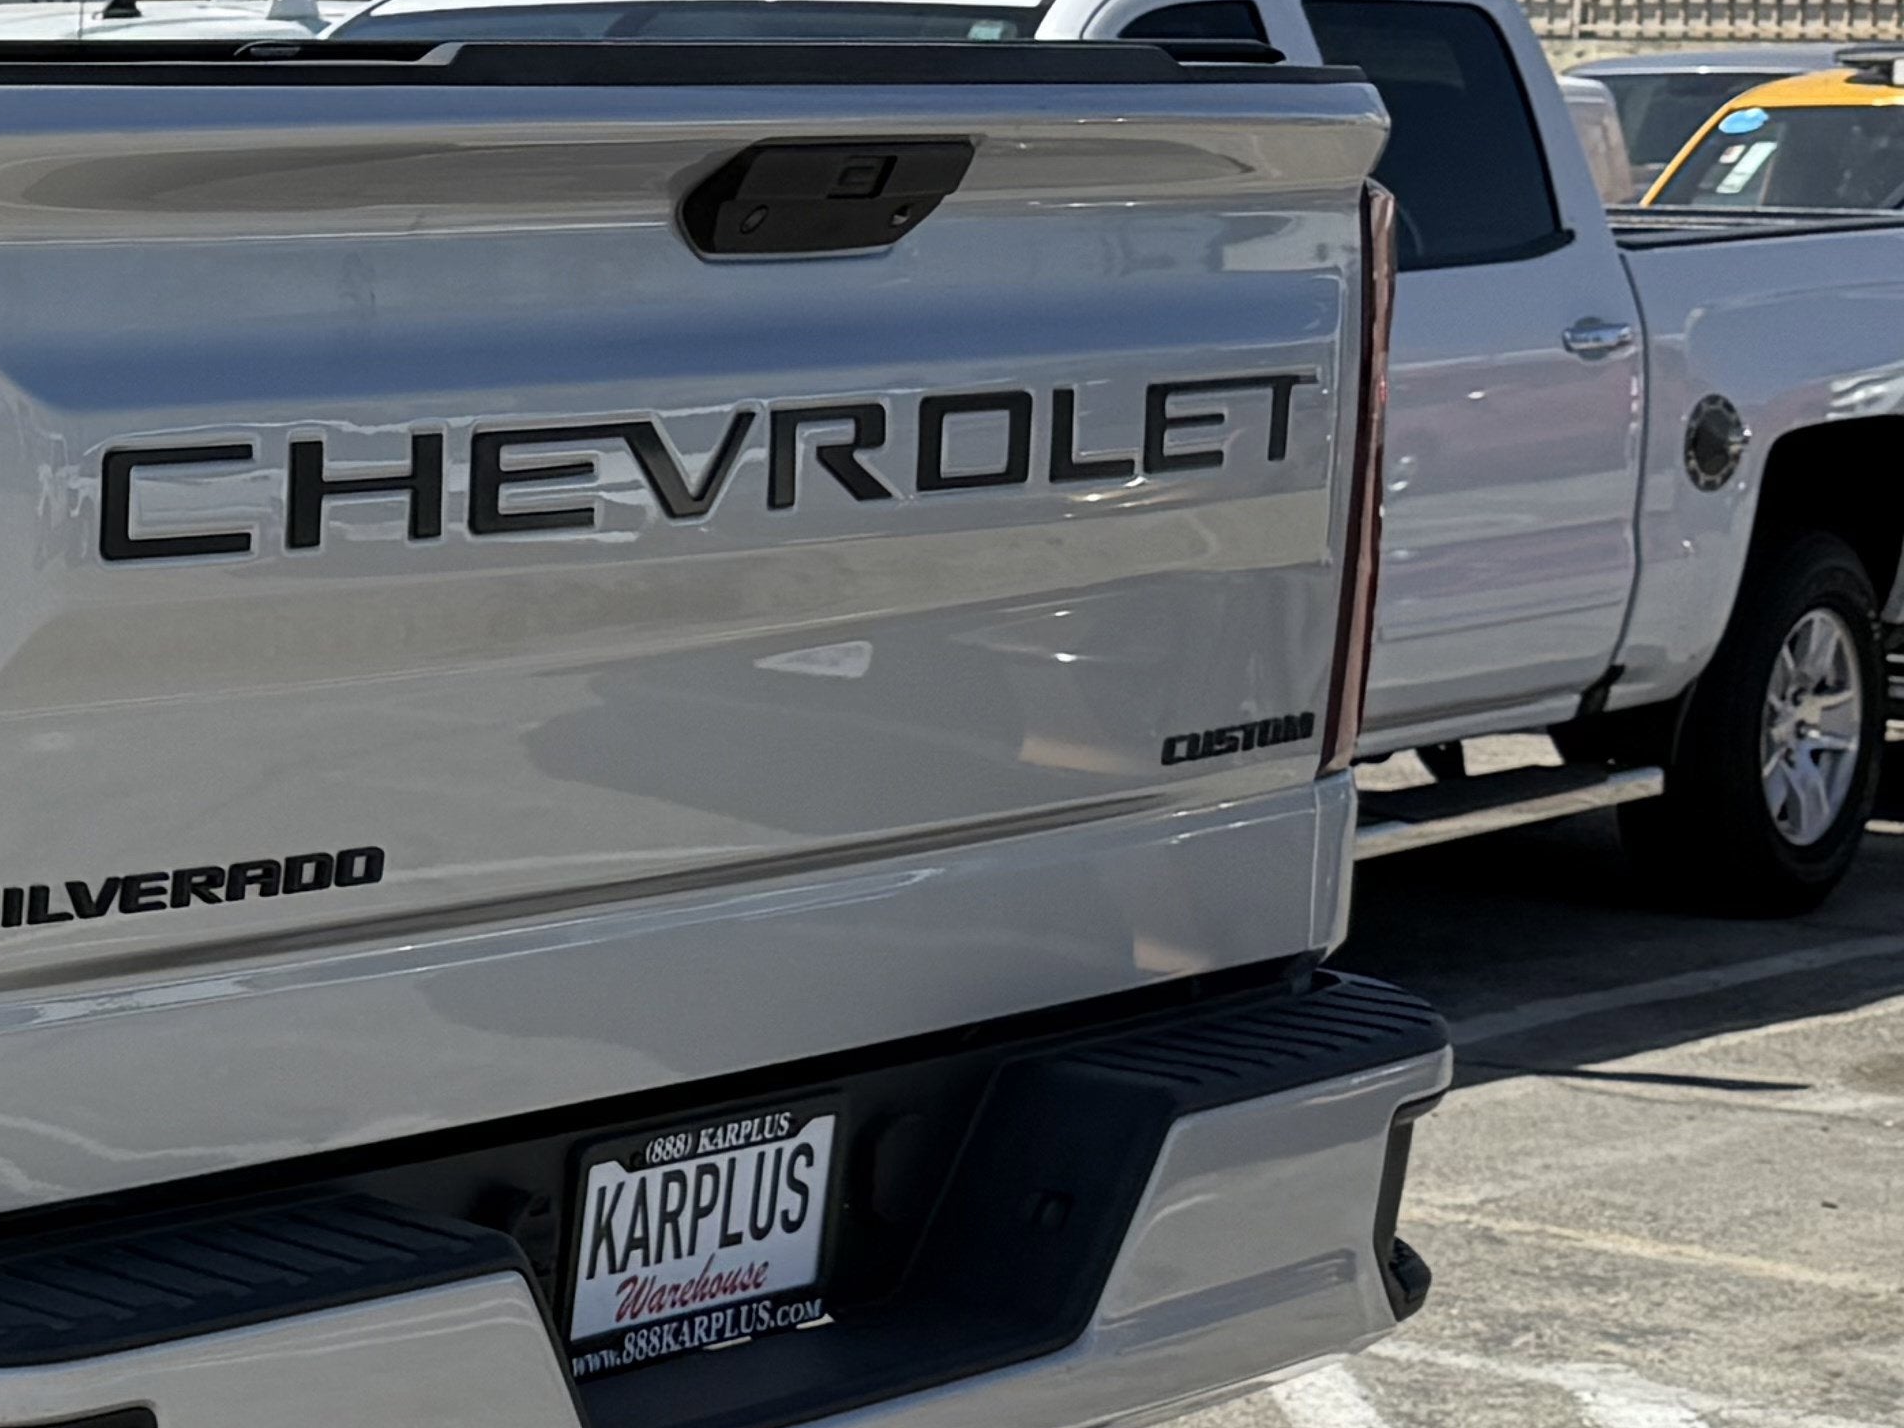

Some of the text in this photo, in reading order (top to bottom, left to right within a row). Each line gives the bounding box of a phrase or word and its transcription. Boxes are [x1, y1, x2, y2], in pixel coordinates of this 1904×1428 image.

[99, 374, 1319, 561] CHEVROLET
[1161, 711, 1315, 766] CUSTOM
[645, 1111, 792, 1164] (888) KARPLUS
[586, 1141, 814, 1281] KARPLUS
[614, 1252, 770, 1323] Warehouse
